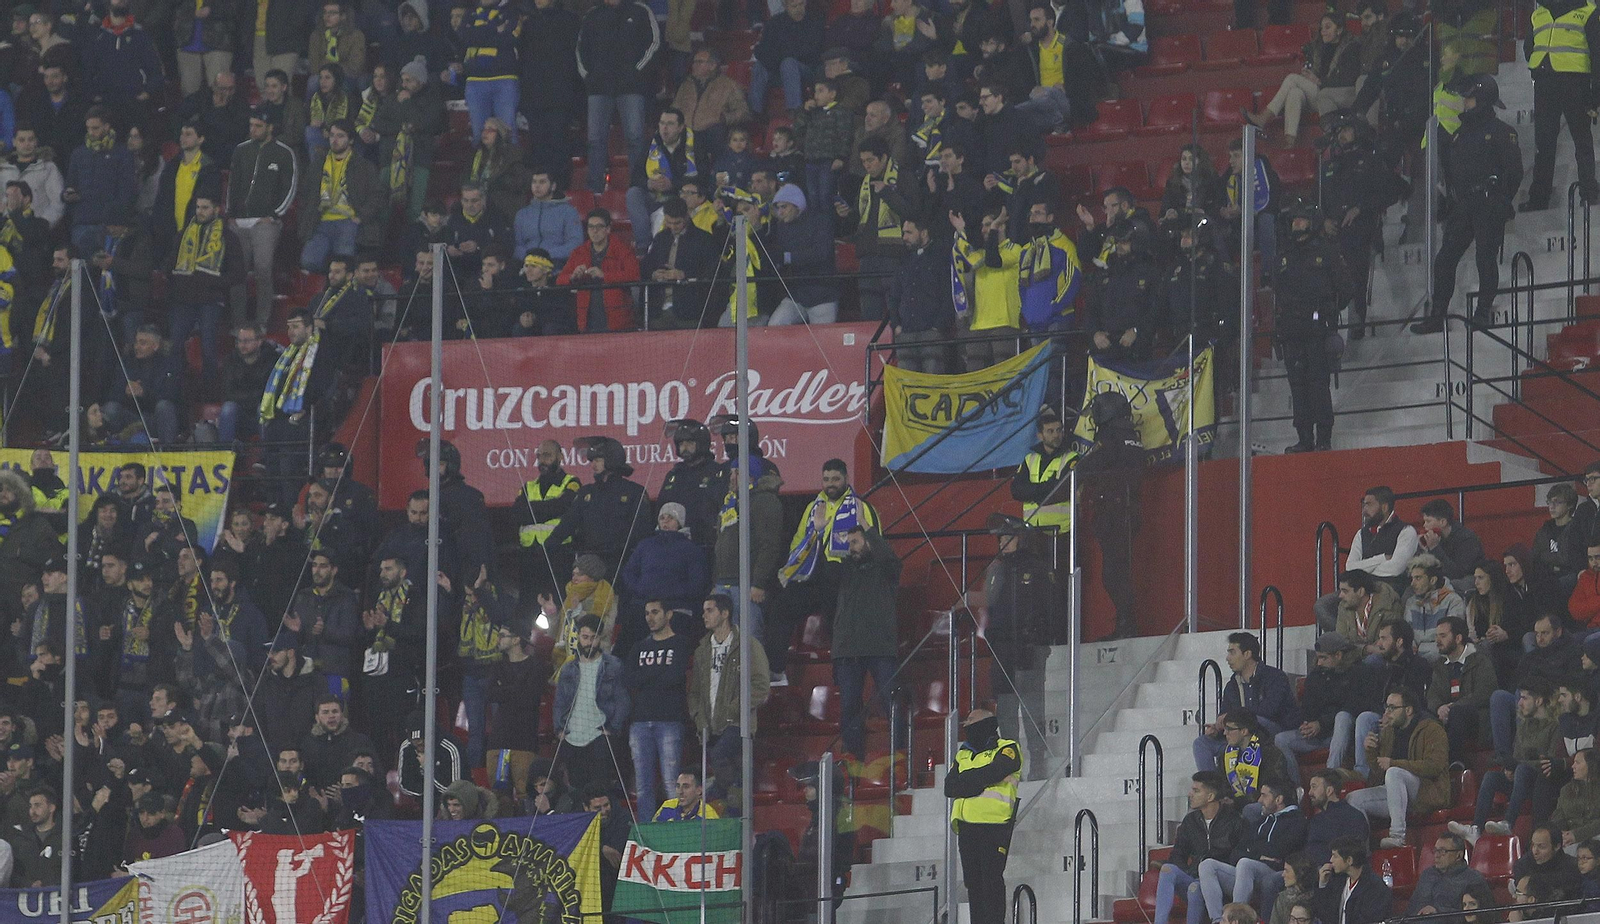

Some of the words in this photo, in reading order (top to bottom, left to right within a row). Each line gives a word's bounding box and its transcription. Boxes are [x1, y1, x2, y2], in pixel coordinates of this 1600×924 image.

[409, 375, 690, 437] Cruzcampo
[705, 368, 867, 426] Radler
[486, 447, 529, 469] CON
[624, 843, 743, 889] KKCH
[915, 864, 938, 881] F4
